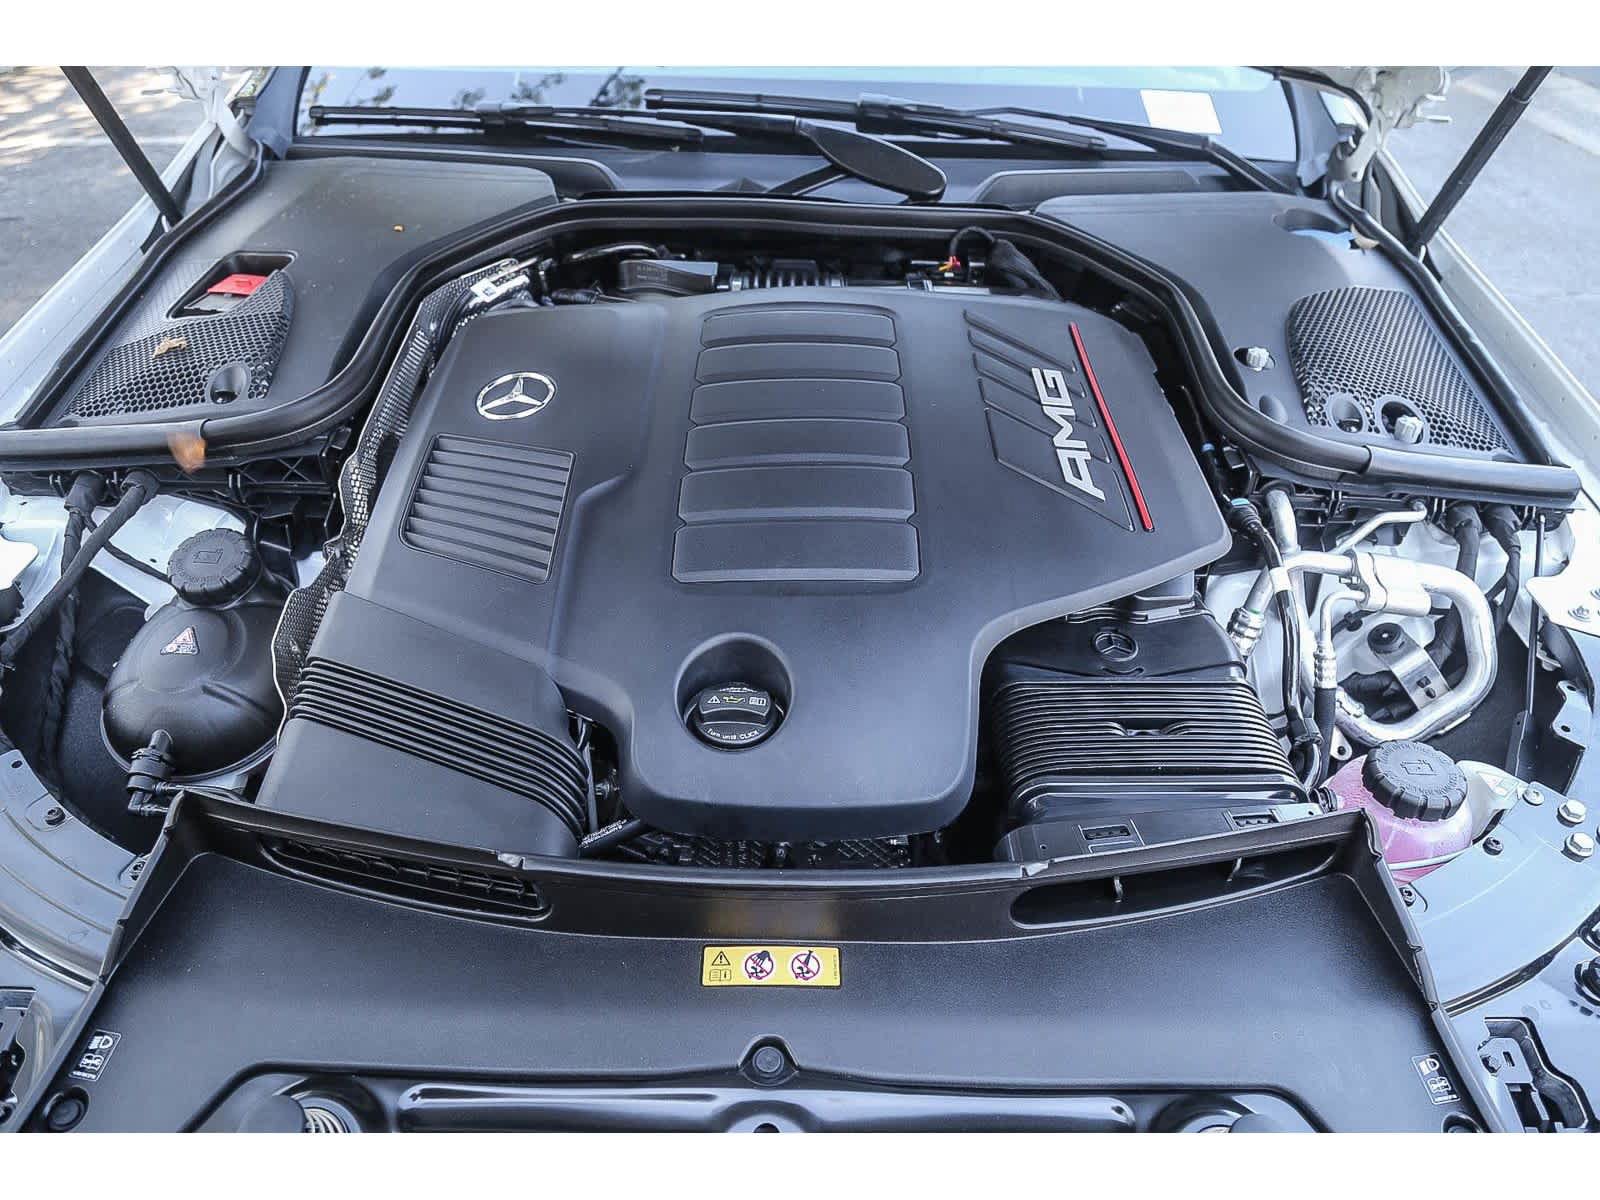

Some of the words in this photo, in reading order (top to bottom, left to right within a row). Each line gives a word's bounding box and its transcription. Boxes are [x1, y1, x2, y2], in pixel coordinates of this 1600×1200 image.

[1031, 367, 1106, 502] AMG
[707, 728, 721, 738] Turn
[739, 730, 760, 740] CLICK
